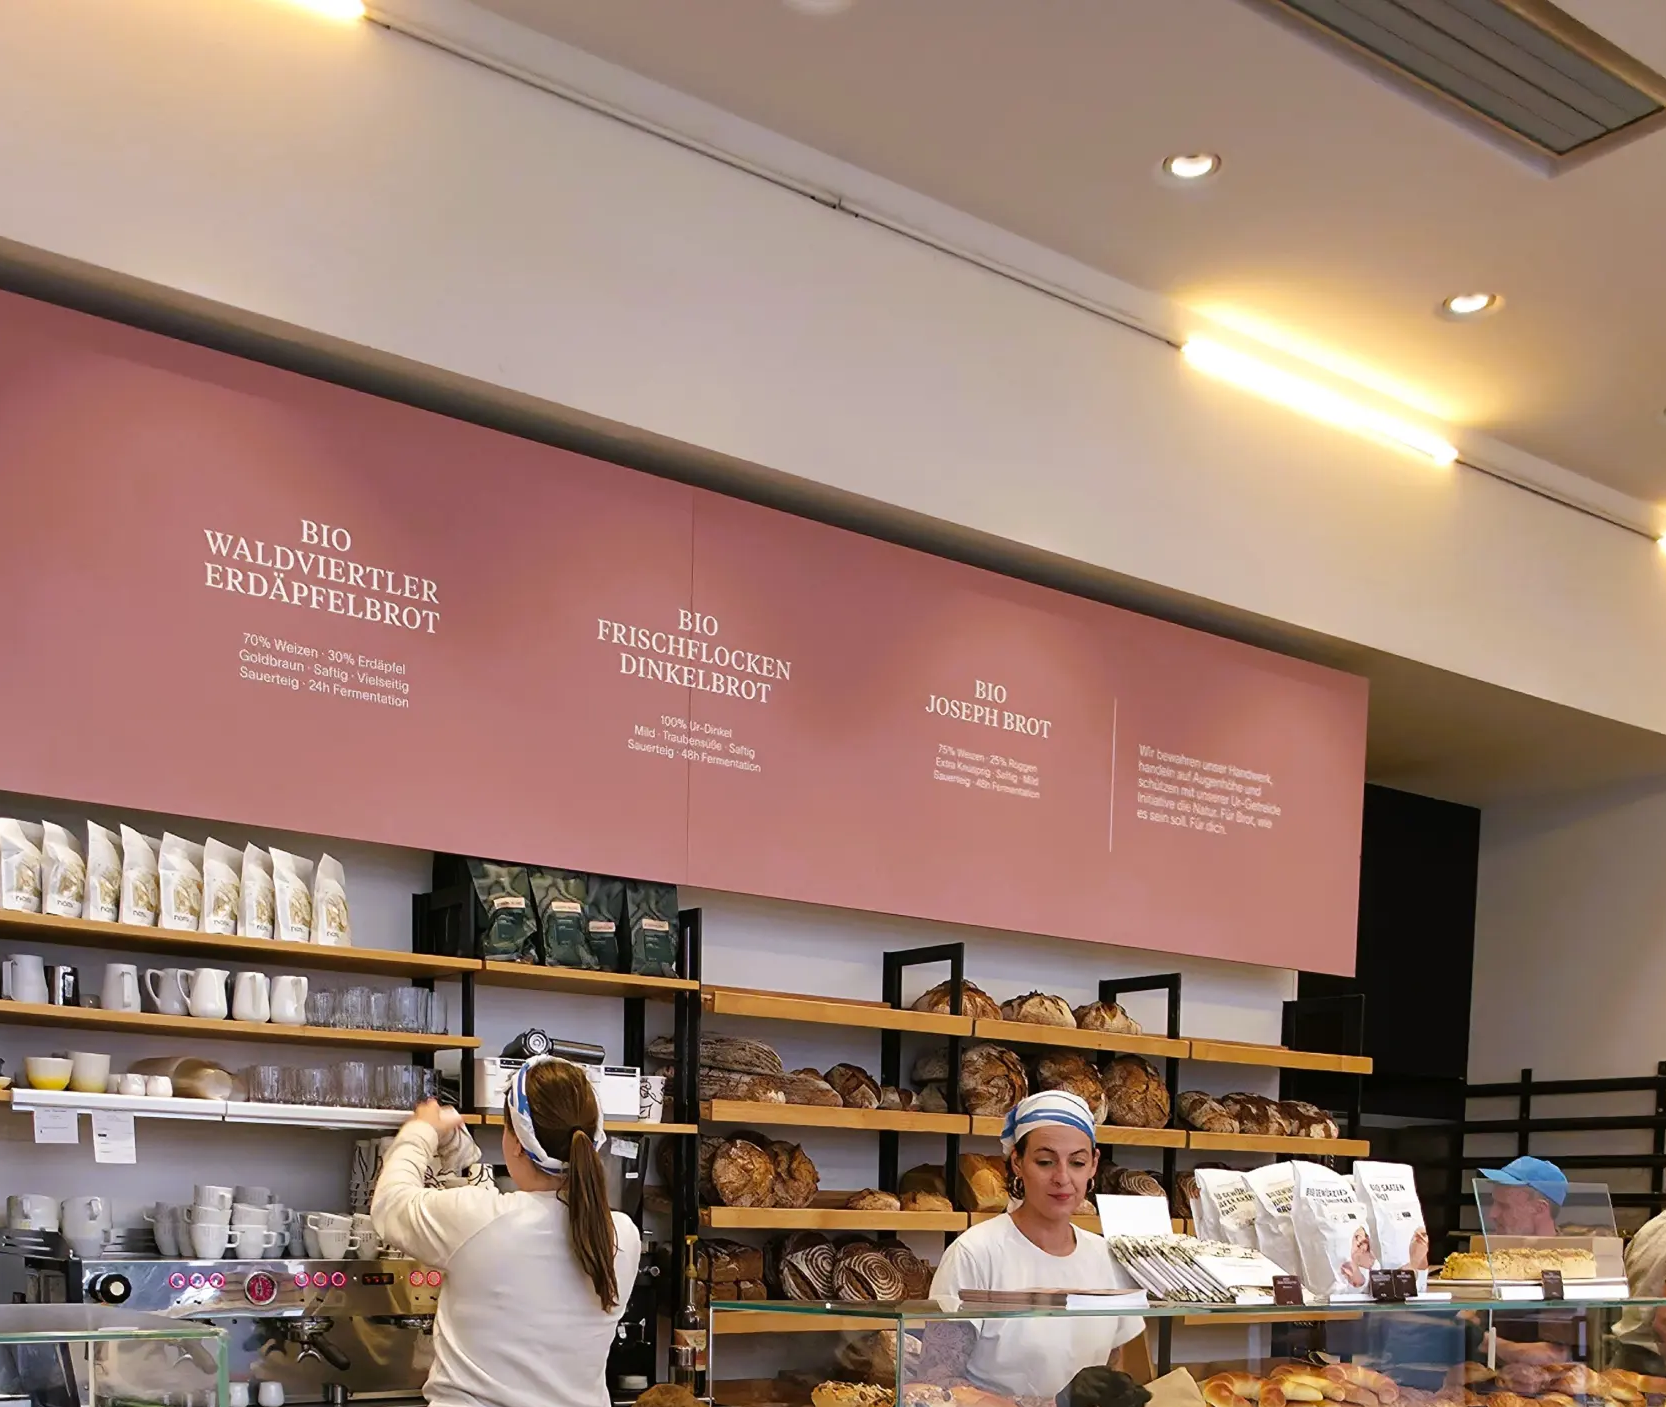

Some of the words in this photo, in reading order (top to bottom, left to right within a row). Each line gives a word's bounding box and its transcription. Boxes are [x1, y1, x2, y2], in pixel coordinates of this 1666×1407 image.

[301, 519, 352, 552] BIO
[203, 528, 440, 605] WALDVIERTLER
[204, 561, 440, 634] ERDÄPFELBROT
[678, 608, 719, 636] BIO
[242, 632, 271, 649] 70%
[274, 638, 319, 658] Weizen
[328, 649, 355, 666] 30%
[358, 655, 406, 675] Erdäpfel
[597, 618, 792, 681] FRISCHFLOCKEN
[239, 649, 305, 673] Goldbraun
[313, 663, 349, 683] Saftig
[357, 671, 409, 695] Vielseitig
[239, 665, 299, 690] Sauerteig
[309, 679, 330, 694] 24h
[333, 683, 409, 708] Fermentation
[620, 652, 771, 704] DINKELBROT
[974, 679, 1007, 704] BIO
[661, 714, 688, 730] 100%
[690, 720, 733, 738] Ur-Dinkel
[925, 694, 998, 728] JOSEPH
[1002, 710, 1052, 739] BROT
[628, 739, 674, 759] Sauerteig
[681, 750, 700, 761] 48h
[701, 753, 761, 773] Fermentation
[634, 724, 656, 738] Mild
[663, 730, 722, 751] Traubensüße
[729, 743, 756, 760] Saftig
